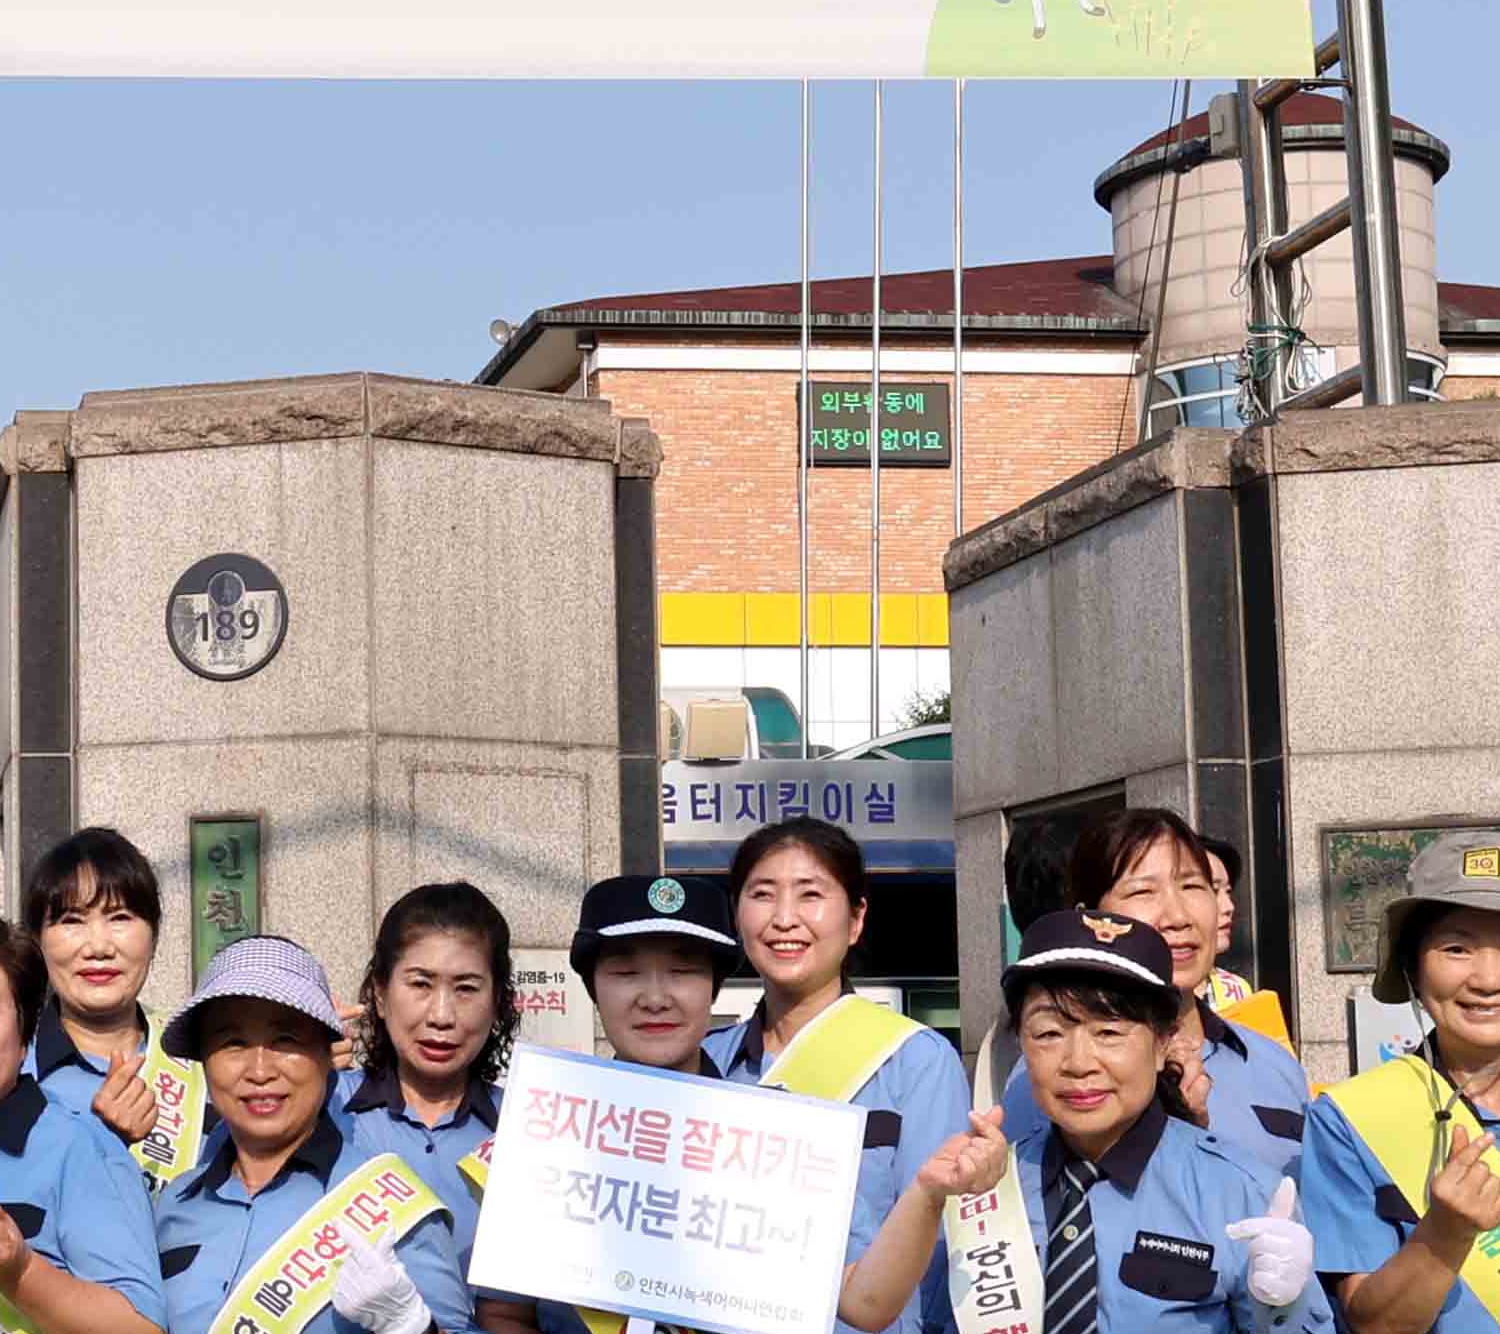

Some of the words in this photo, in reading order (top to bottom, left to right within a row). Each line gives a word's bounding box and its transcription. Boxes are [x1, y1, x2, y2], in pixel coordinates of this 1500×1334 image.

[881, 428, 943, 452] 없어요
[195, 609, 260, 642] 189
[522, 1087, 673, 1165] 정지선을
[349, 1170, 419, 1235] 무단
[253, 1223, 350, 1323] 횡단을
[965, 1239, 1023, 1317] 당신의
